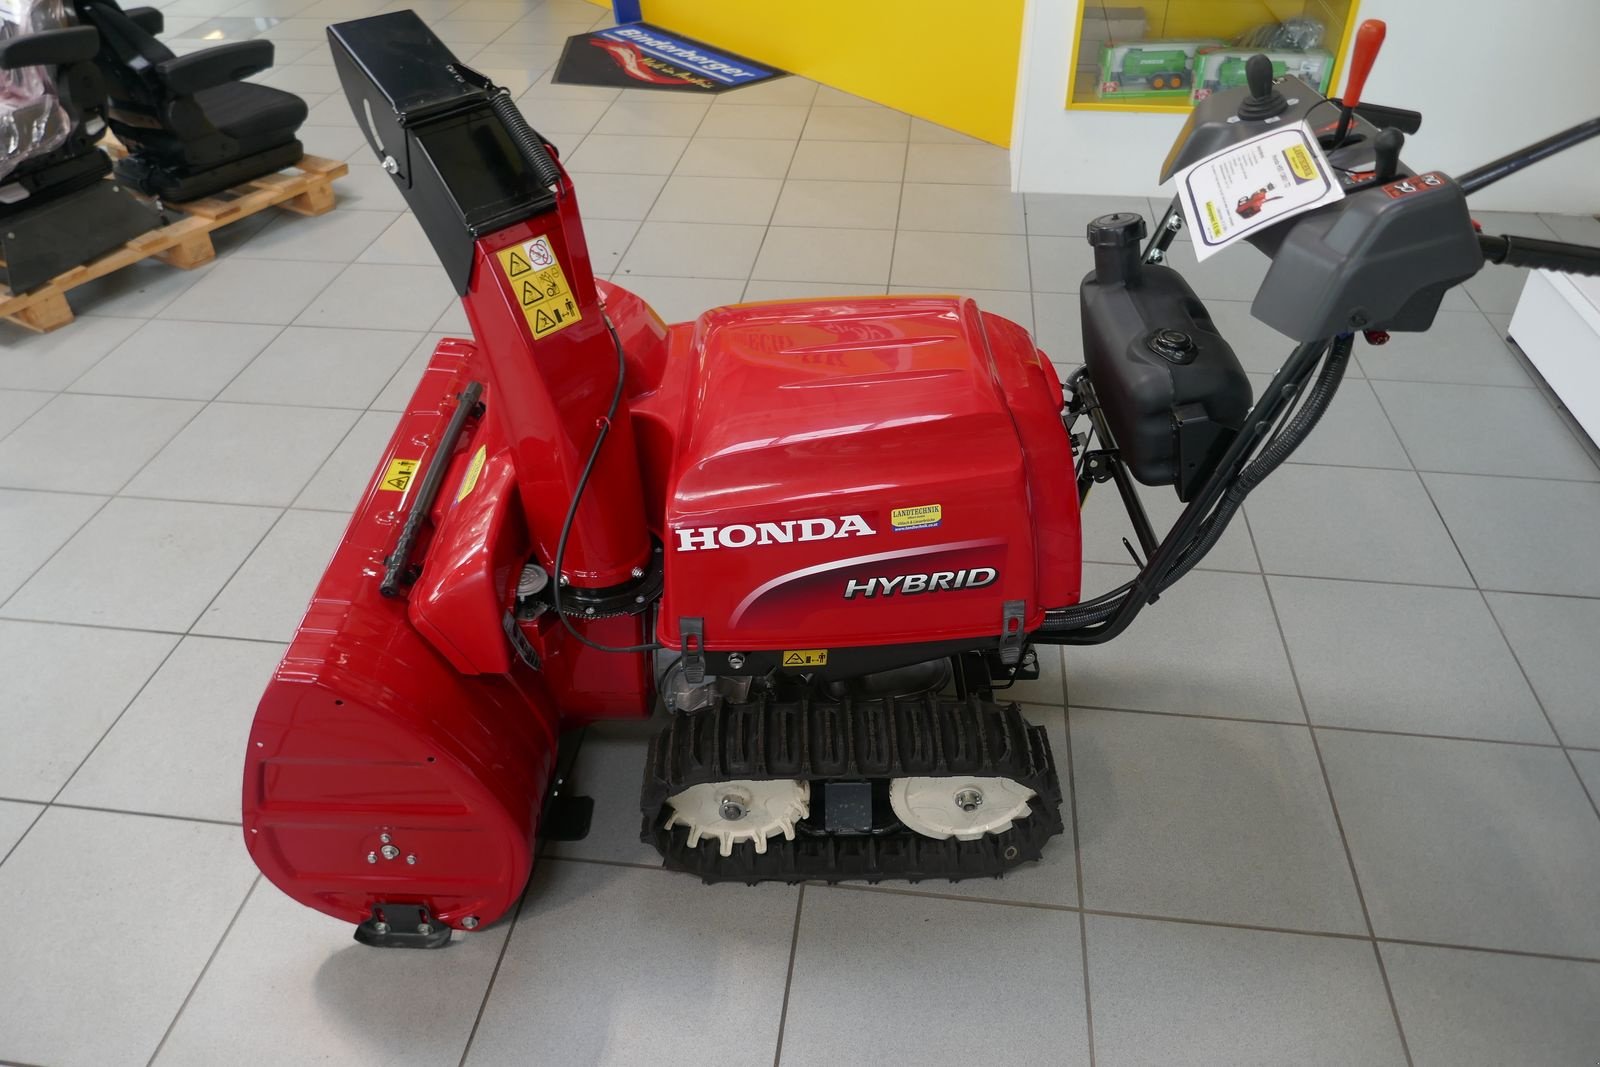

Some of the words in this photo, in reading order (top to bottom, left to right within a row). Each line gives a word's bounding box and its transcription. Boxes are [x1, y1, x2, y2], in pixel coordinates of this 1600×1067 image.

[614, 28, 756, 78] Binderberger
[893, 506, 939, 517] LANDTECHNIK
[676, 514, 877, 551] HONDA
[843, 567, 997, 598] HYBRID
